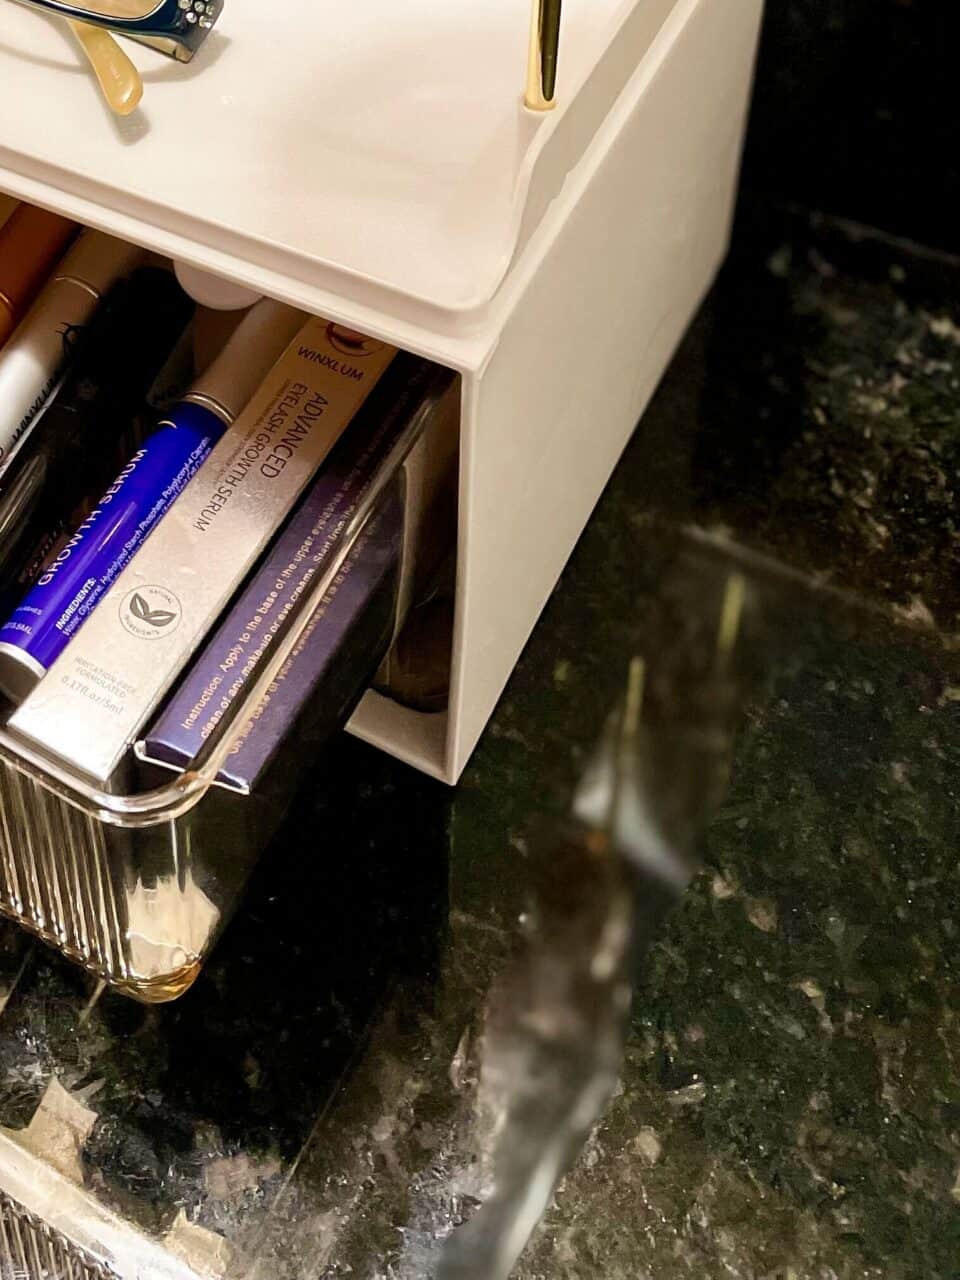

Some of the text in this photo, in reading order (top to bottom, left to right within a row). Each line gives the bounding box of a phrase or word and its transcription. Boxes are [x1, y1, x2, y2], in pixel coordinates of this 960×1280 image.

[298, 346, 364, 382] WINXLUM
[265, 382, 307, 433] EYELASH
[225, 430, 272, 488] GROWTH
[260, 391, 328, 479] ADVANCED
[38, 510, 102, 586] GROWTH
[99, 448, 148, 505] SERUM
[193, 487, 232, 532] SERUM
[53, 576, 98, 630] INGREDIENTS:
[219, 642, 245, 674] Apply
[237, 630, 252, 644] to
[245, 612, 263, 632] the
[256, 588, 279, 615] base
[272, 576, 287, 591] of
[280, 560, 298, 580] the
[292, 533, 317, 564] upper
[216, 694, 231, 709] of
